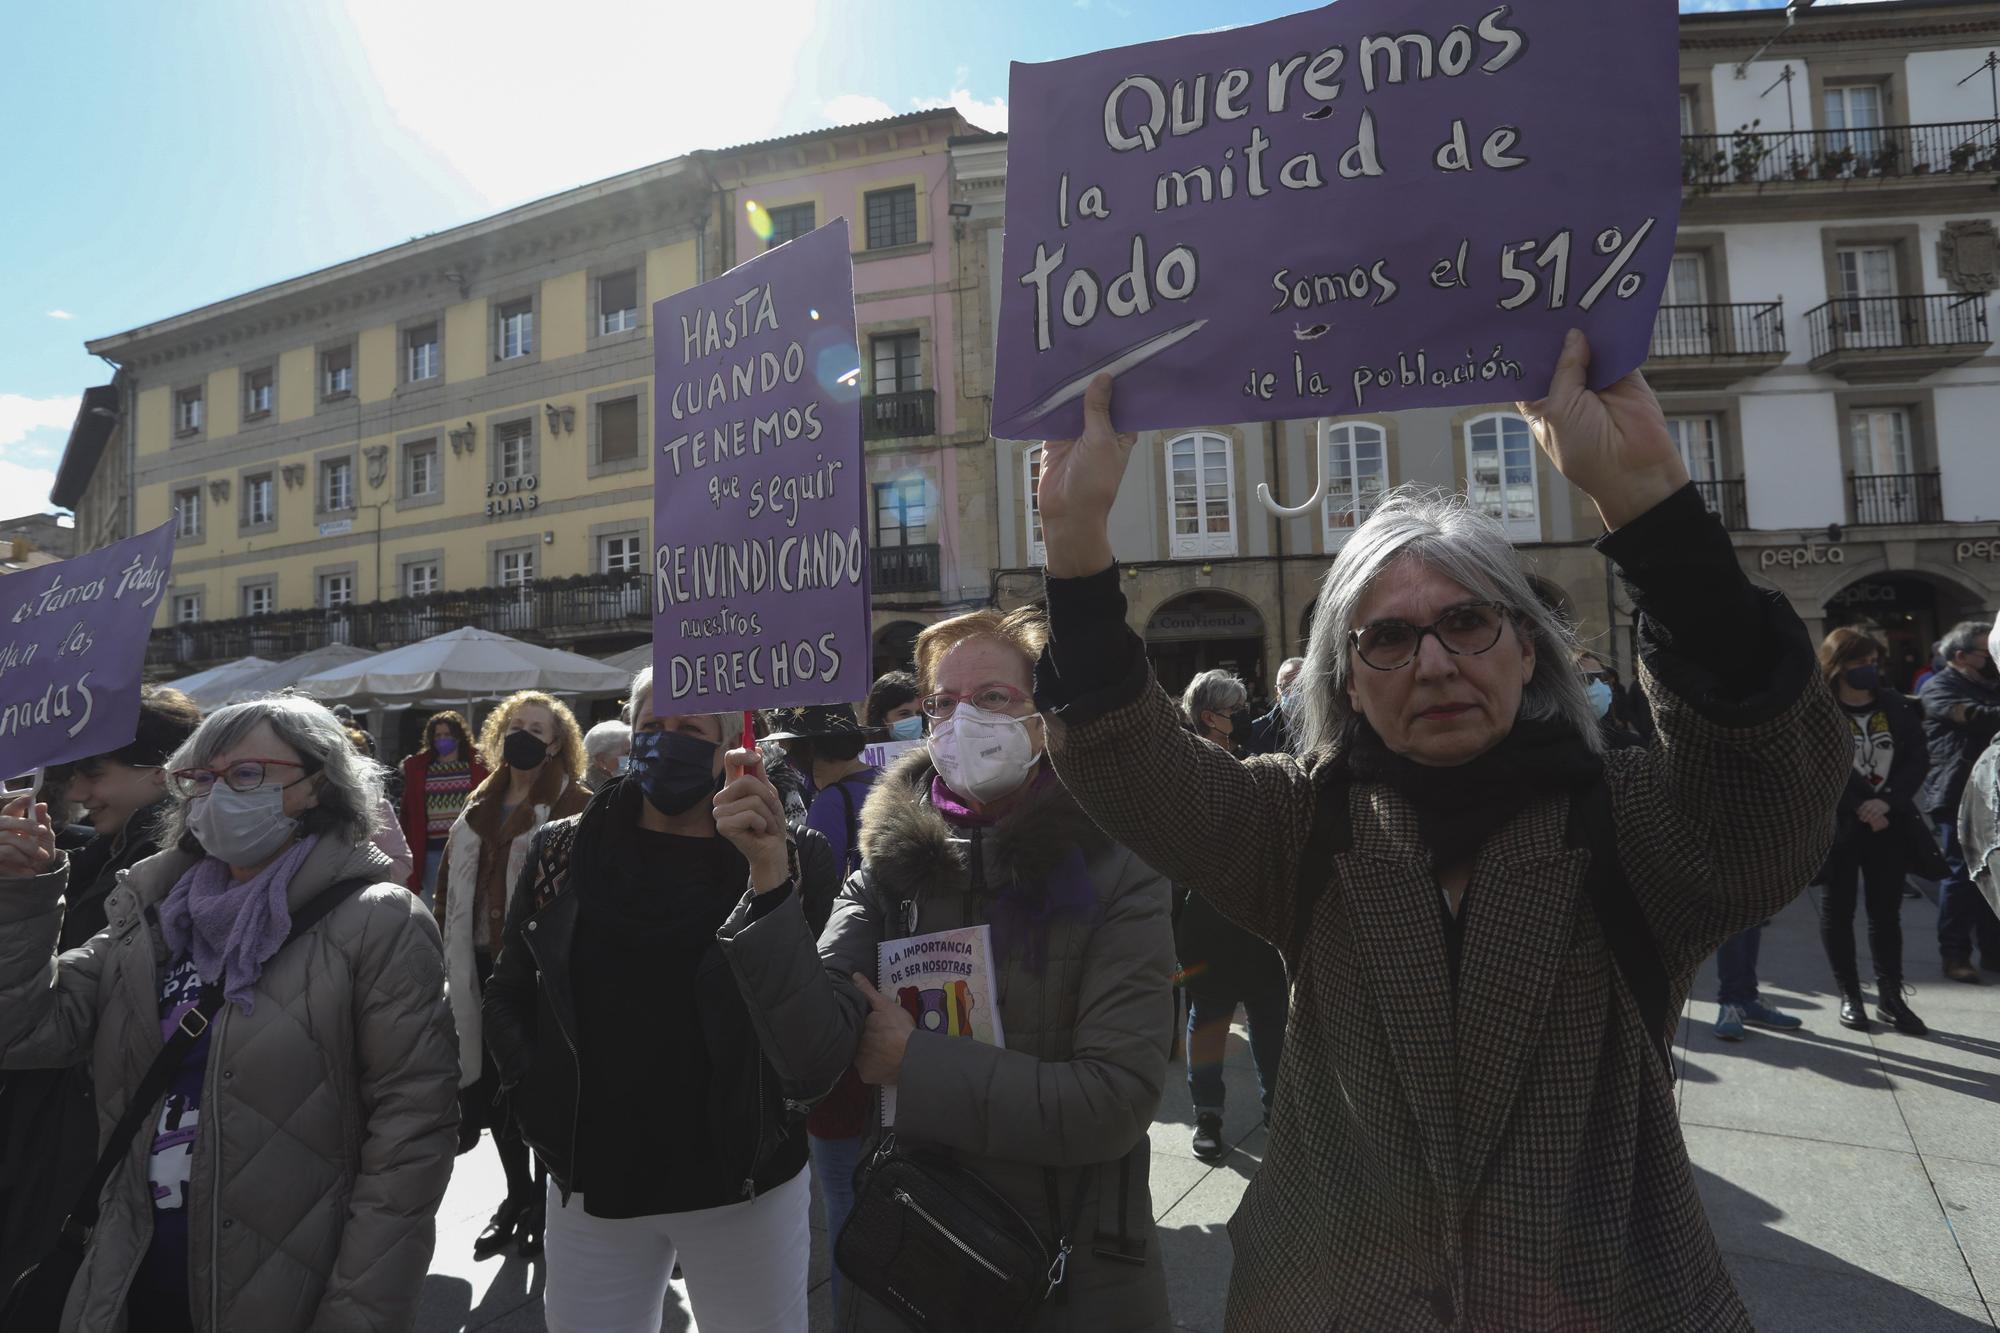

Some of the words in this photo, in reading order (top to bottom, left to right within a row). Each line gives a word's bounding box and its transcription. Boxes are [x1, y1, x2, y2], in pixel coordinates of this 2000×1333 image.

[1104, 6, 1525, 153] Queremos
[1058, 173, 1110, 228] la
[1155, 105, 1384, 213] mitad
[1434, 119, 1527, 173] de
[1019, 234, 1198, 352] todo
[1429, 239, 1469, 290] el
[1496, 217, 1655, 312] 51%
[681, 282, 779, 365] HASTA
[671, 341, 804, 420] CUANDO
[1243, 367, 1275, 398] de
[1294, 351, 1329, 398] la
[1354, 344, 1524, 407] población
[663, 402, 823, 475] TENEMOS
[486, 475, 538, 497] FOTO
[486, 495, 538, 517] ELIAS
[708, 474, 740, 510] que
[749, 454, 844, 527] seguir
[656, 525, 863, 614] REIVINDICANDO
[1760, 543, 1845, 570] pepita
[680, 605, 763, 638] nuestros
[670, 632, 842, 699] DERECHOS
[888, 951, 902, 966] LA
[903, 941, 973, 959] IMPORTANCIA
[891, 970, 902, 984] DE
[905, 961, 921, 978] SER
[922, 959, 973, 975] NOSOTRAS
